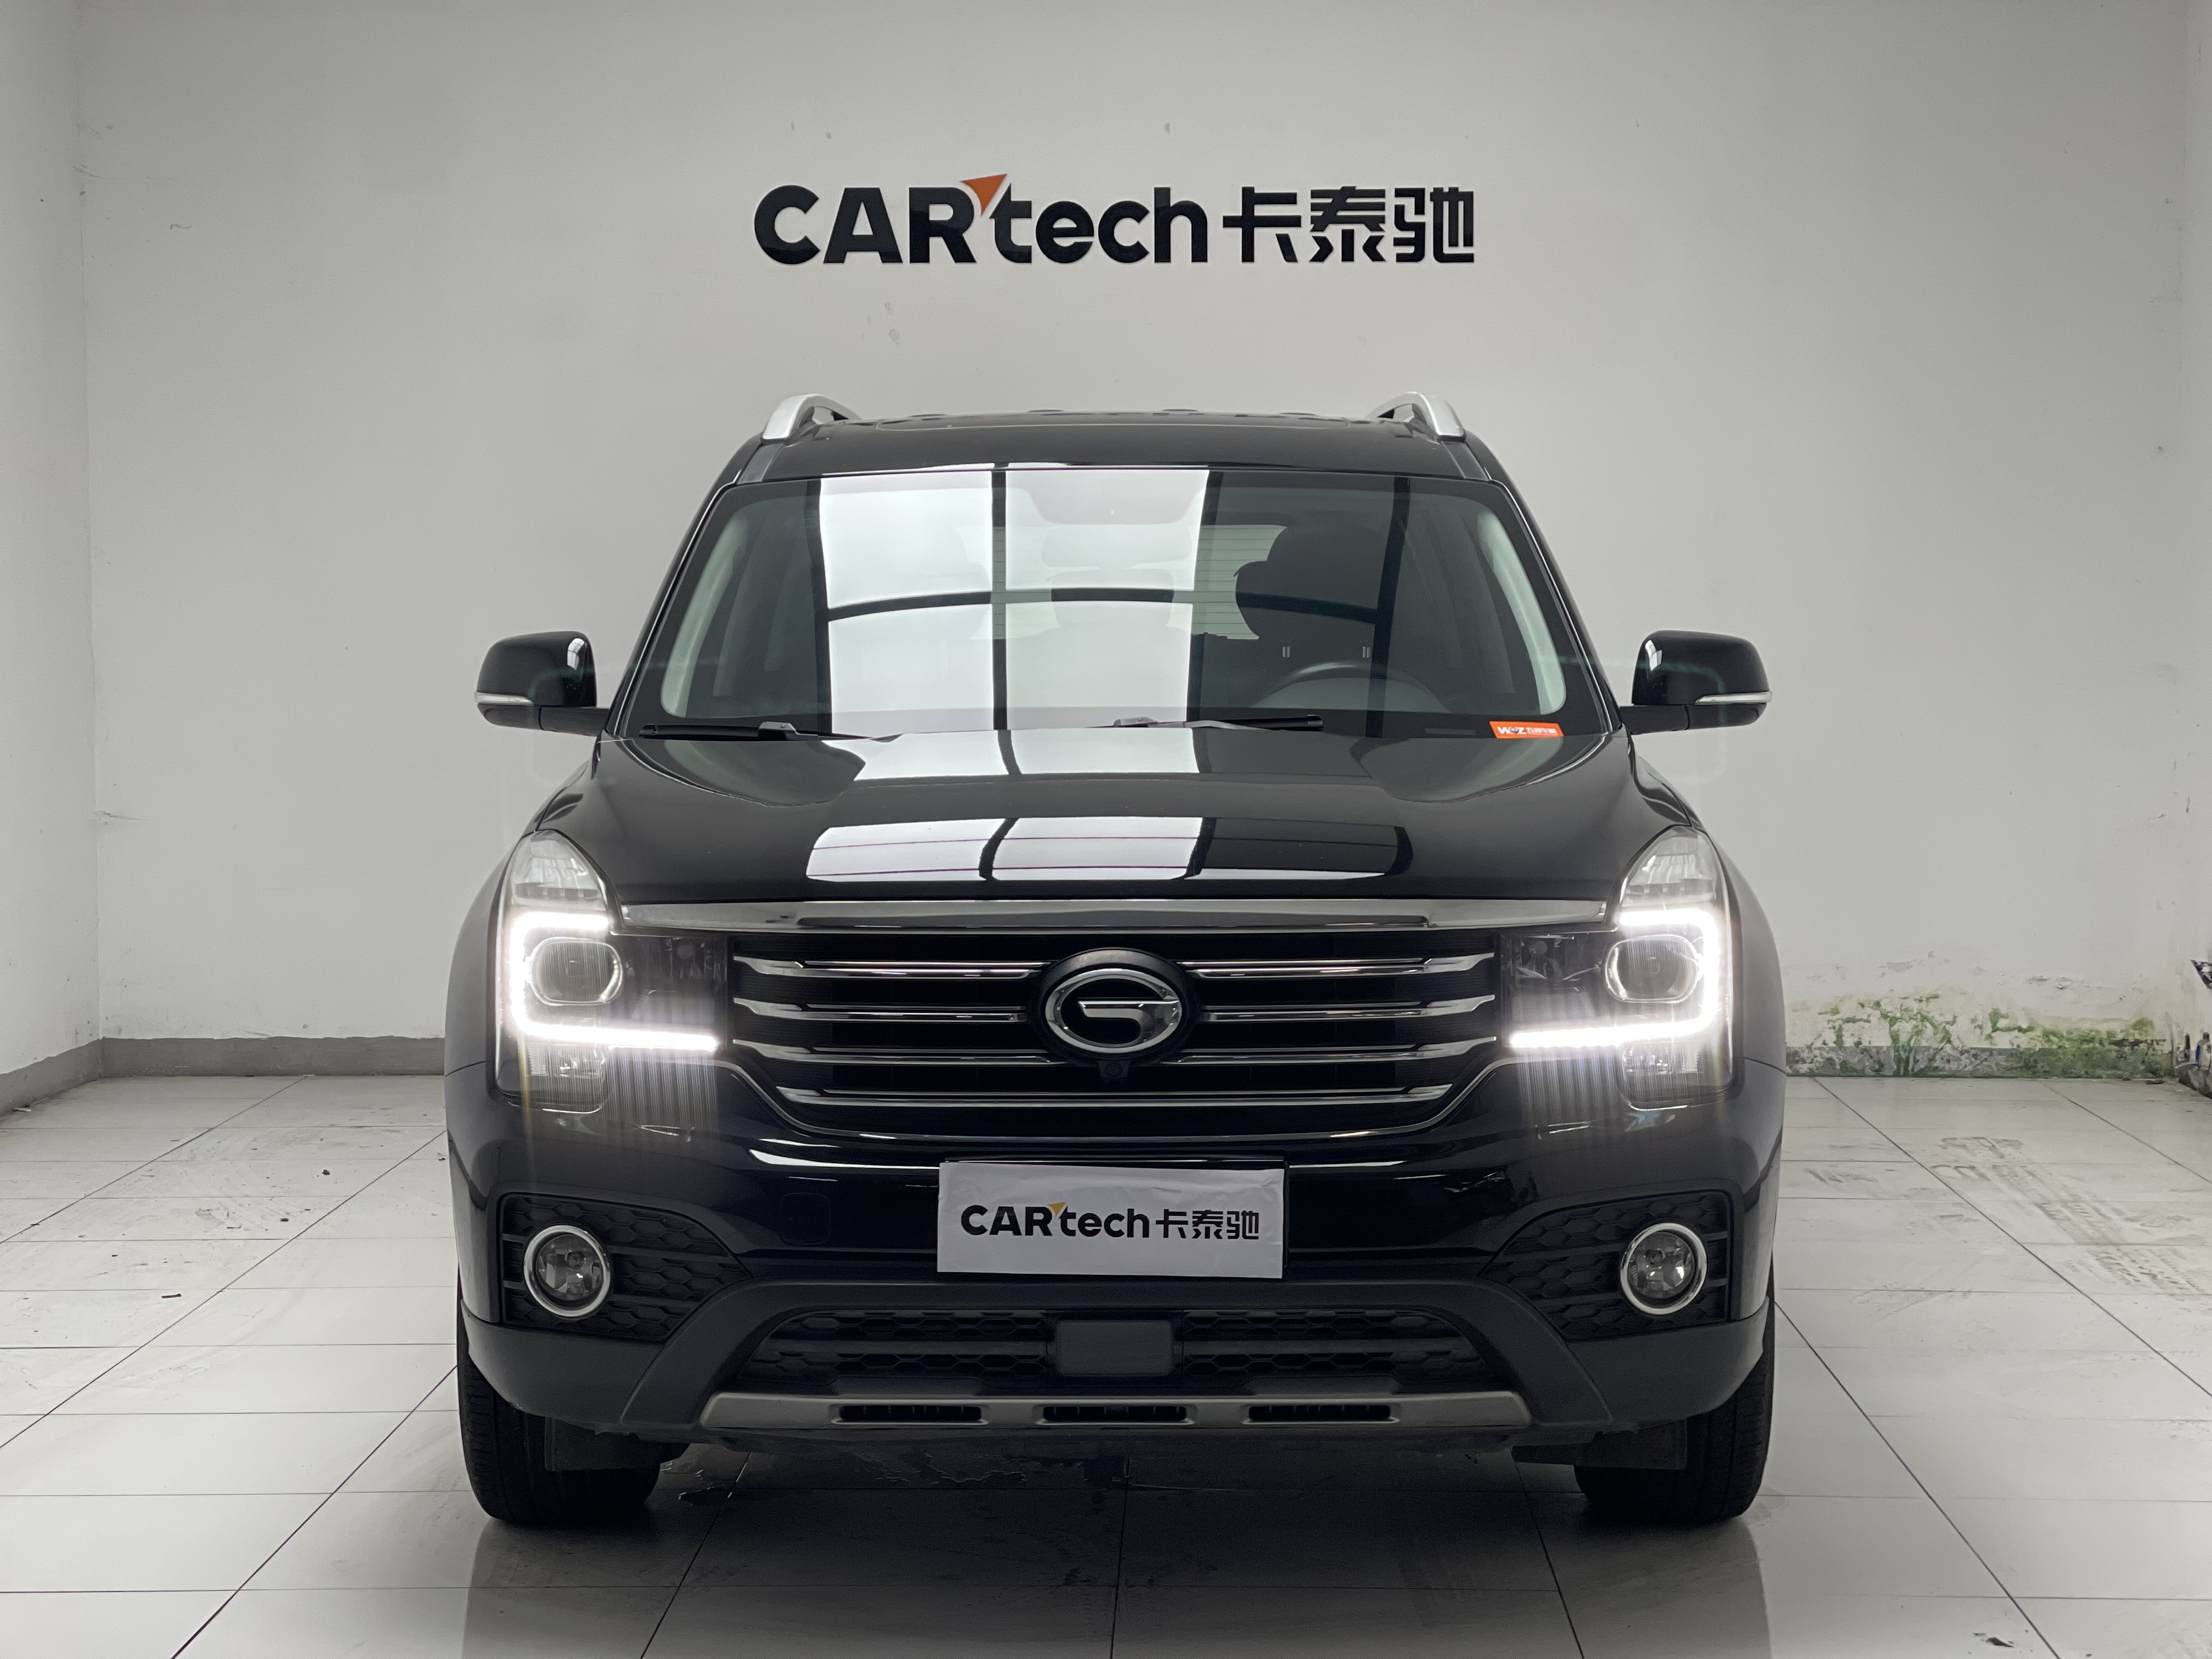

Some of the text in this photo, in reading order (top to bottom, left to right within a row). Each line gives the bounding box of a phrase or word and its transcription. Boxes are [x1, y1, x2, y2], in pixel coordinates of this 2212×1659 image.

[754, 183, 1474, 265] CARtech 卡泰驰
[961, 1205, 1260, 1240] CARtech 卡泰驰
